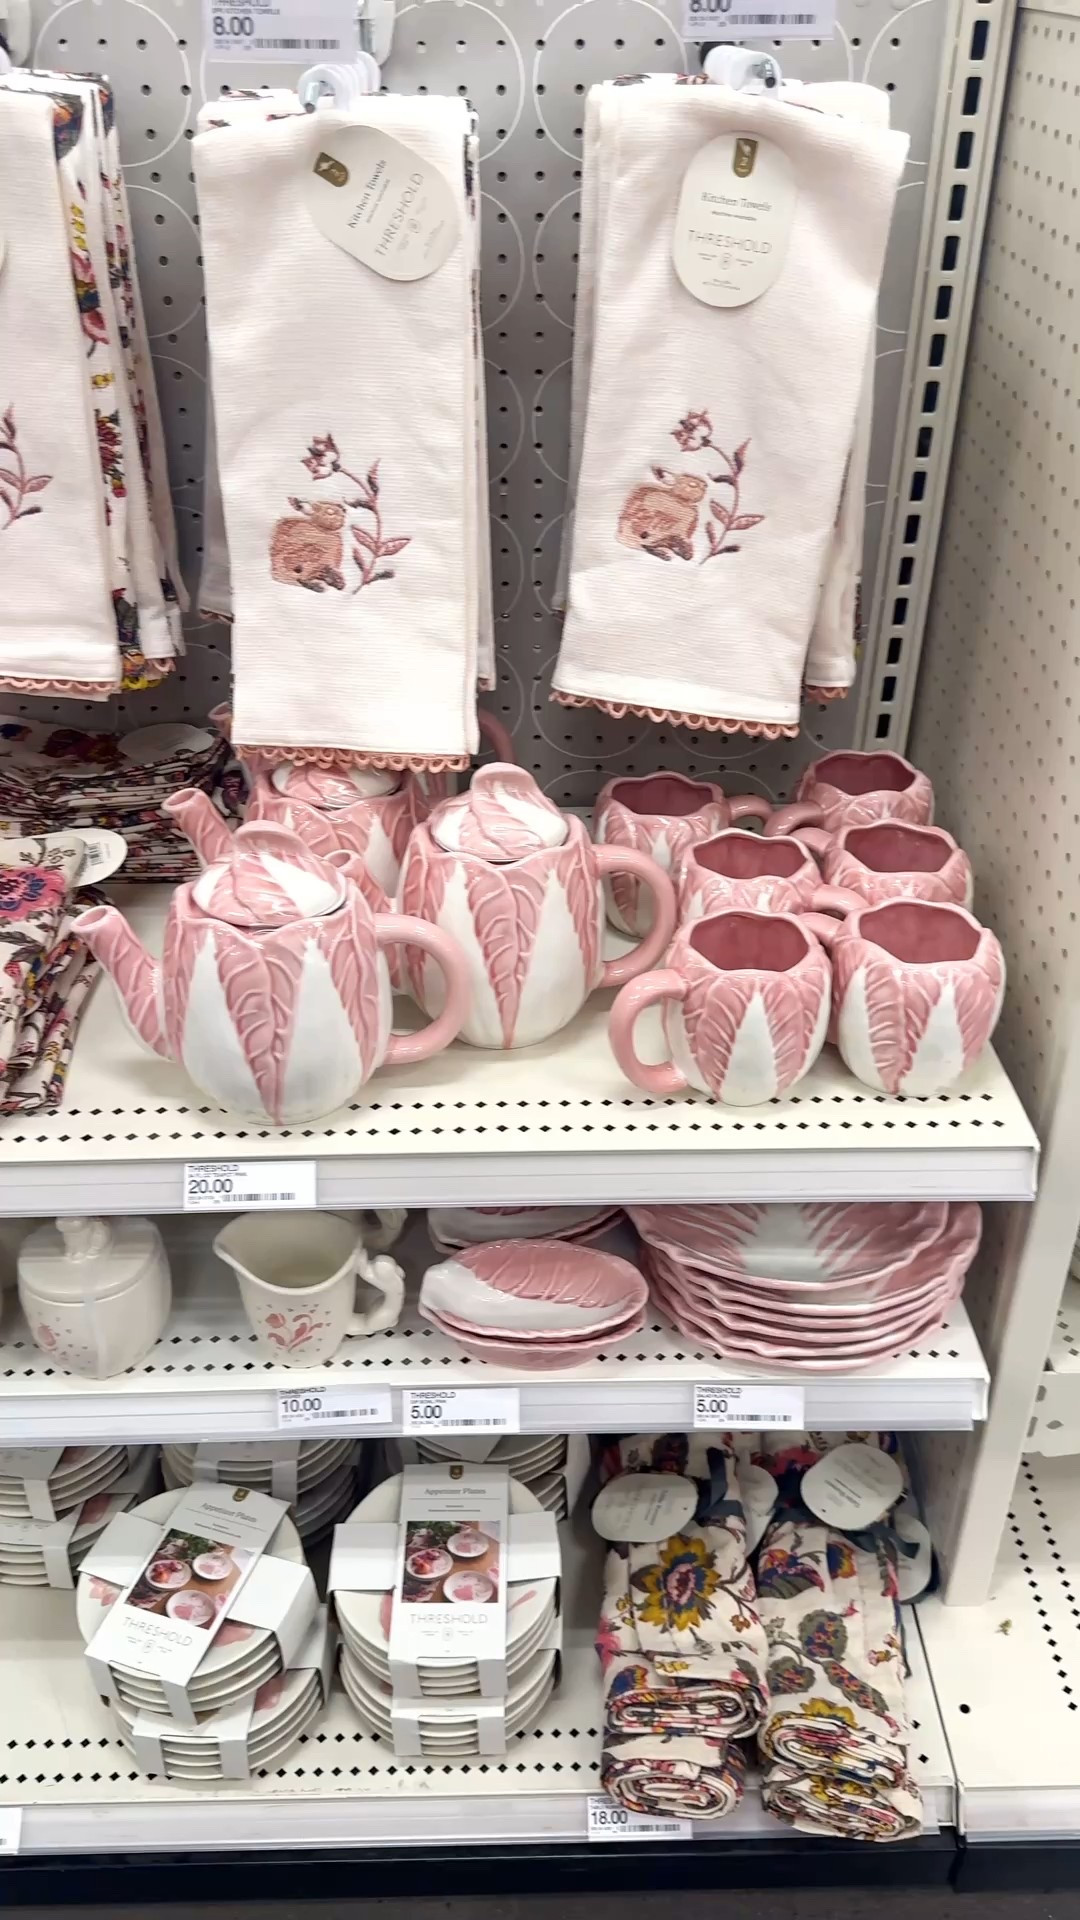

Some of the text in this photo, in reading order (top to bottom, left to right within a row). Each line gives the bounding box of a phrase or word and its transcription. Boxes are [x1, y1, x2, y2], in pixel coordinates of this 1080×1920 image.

[213, 16, 254, 36] 8.00
[346, 191, 371, 229] Kitchen
[366, 160, 387, 190] Towels
[701, 191, 738, 207] Kitchen
[375, 172, 425, 256] THRESHOLD
[689, 229, 773, 255] THRESHOLD
[187, 1164, 240, 1172] THRESHOLD
[188, 1179, 233, 1194] 20.00
[279, 1386, 327, 1395] THRESHOLD
[410, 1391, 457, 1399] THRESHOLD
[696, 1386, 743, 1394] THRESHOLD
[281, 1398, 322, 1413] 10.00
[410, 1405, 443, 1419] 5.00
[696, 1399, 728, 1413] 5.00
[410, 1613, 489, 1624] THRESHOLD
[122, 1616, 193, 1647] THRESHOLD
[590, 1810, 628, 1825] 18.00
